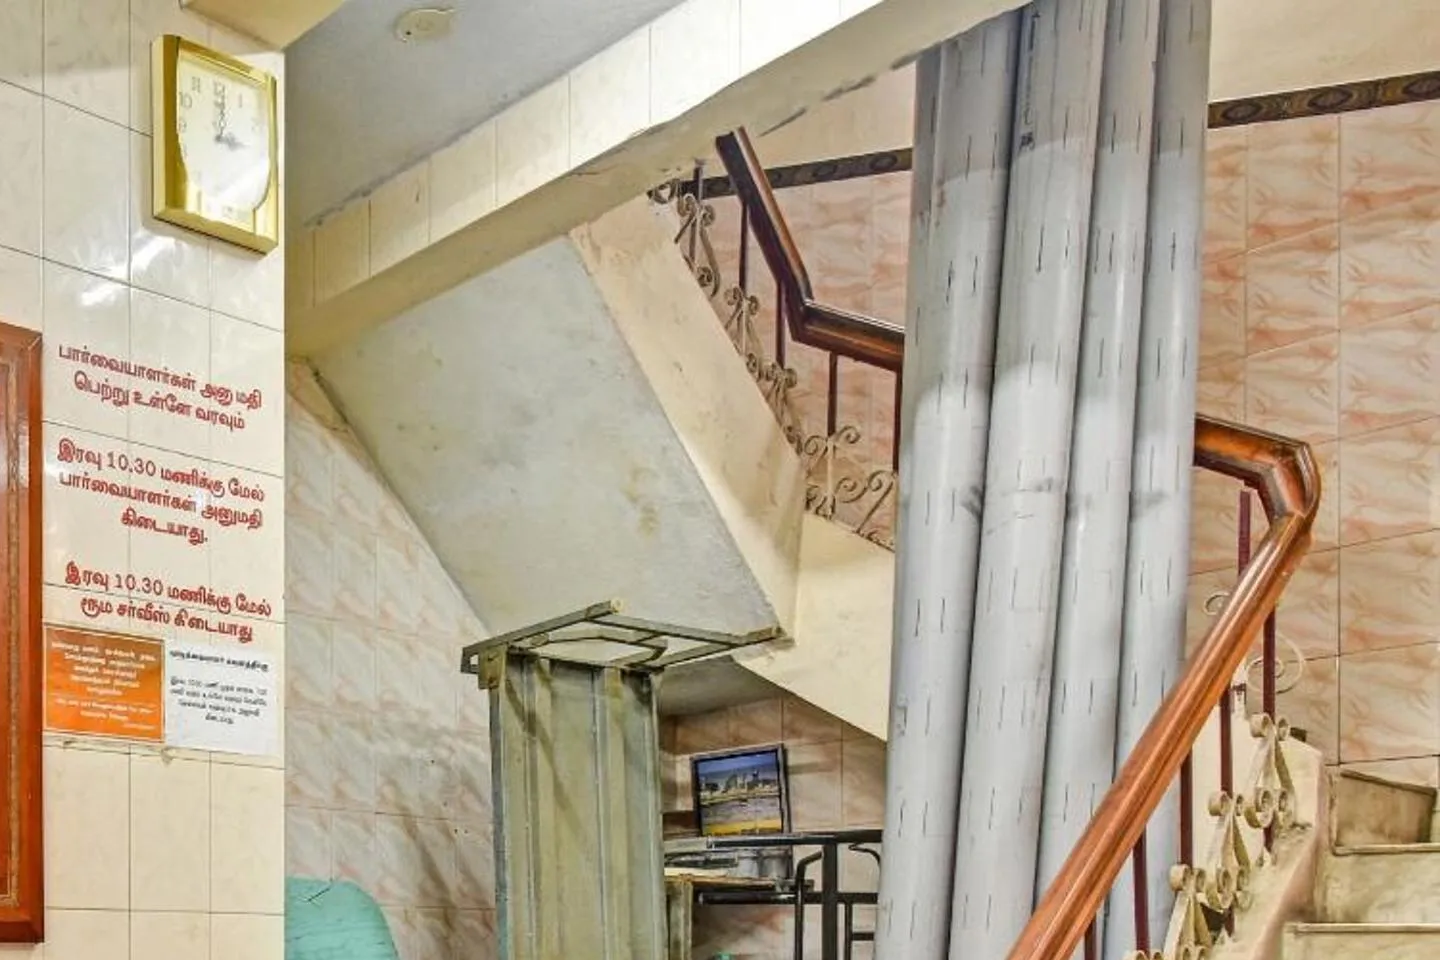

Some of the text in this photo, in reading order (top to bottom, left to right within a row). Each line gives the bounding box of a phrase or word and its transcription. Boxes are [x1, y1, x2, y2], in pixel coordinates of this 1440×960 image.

[58, 344, 196, 391] பார்வையாளர்கள்
[74, 370, 130, 407] பெற்று
[195, 407, 245, 432] வரவும்
[57, 438, 265, 502] இரவு 10.30 மணிக்கு மேல்
[59, 471, 263, 531] பார்வையாளர்கள் அனுமதி
[65, 560, 272, 617] இரவு 10.30 மணிக்கு மேல்
[174, 608, 253, 644] கிடையாது
